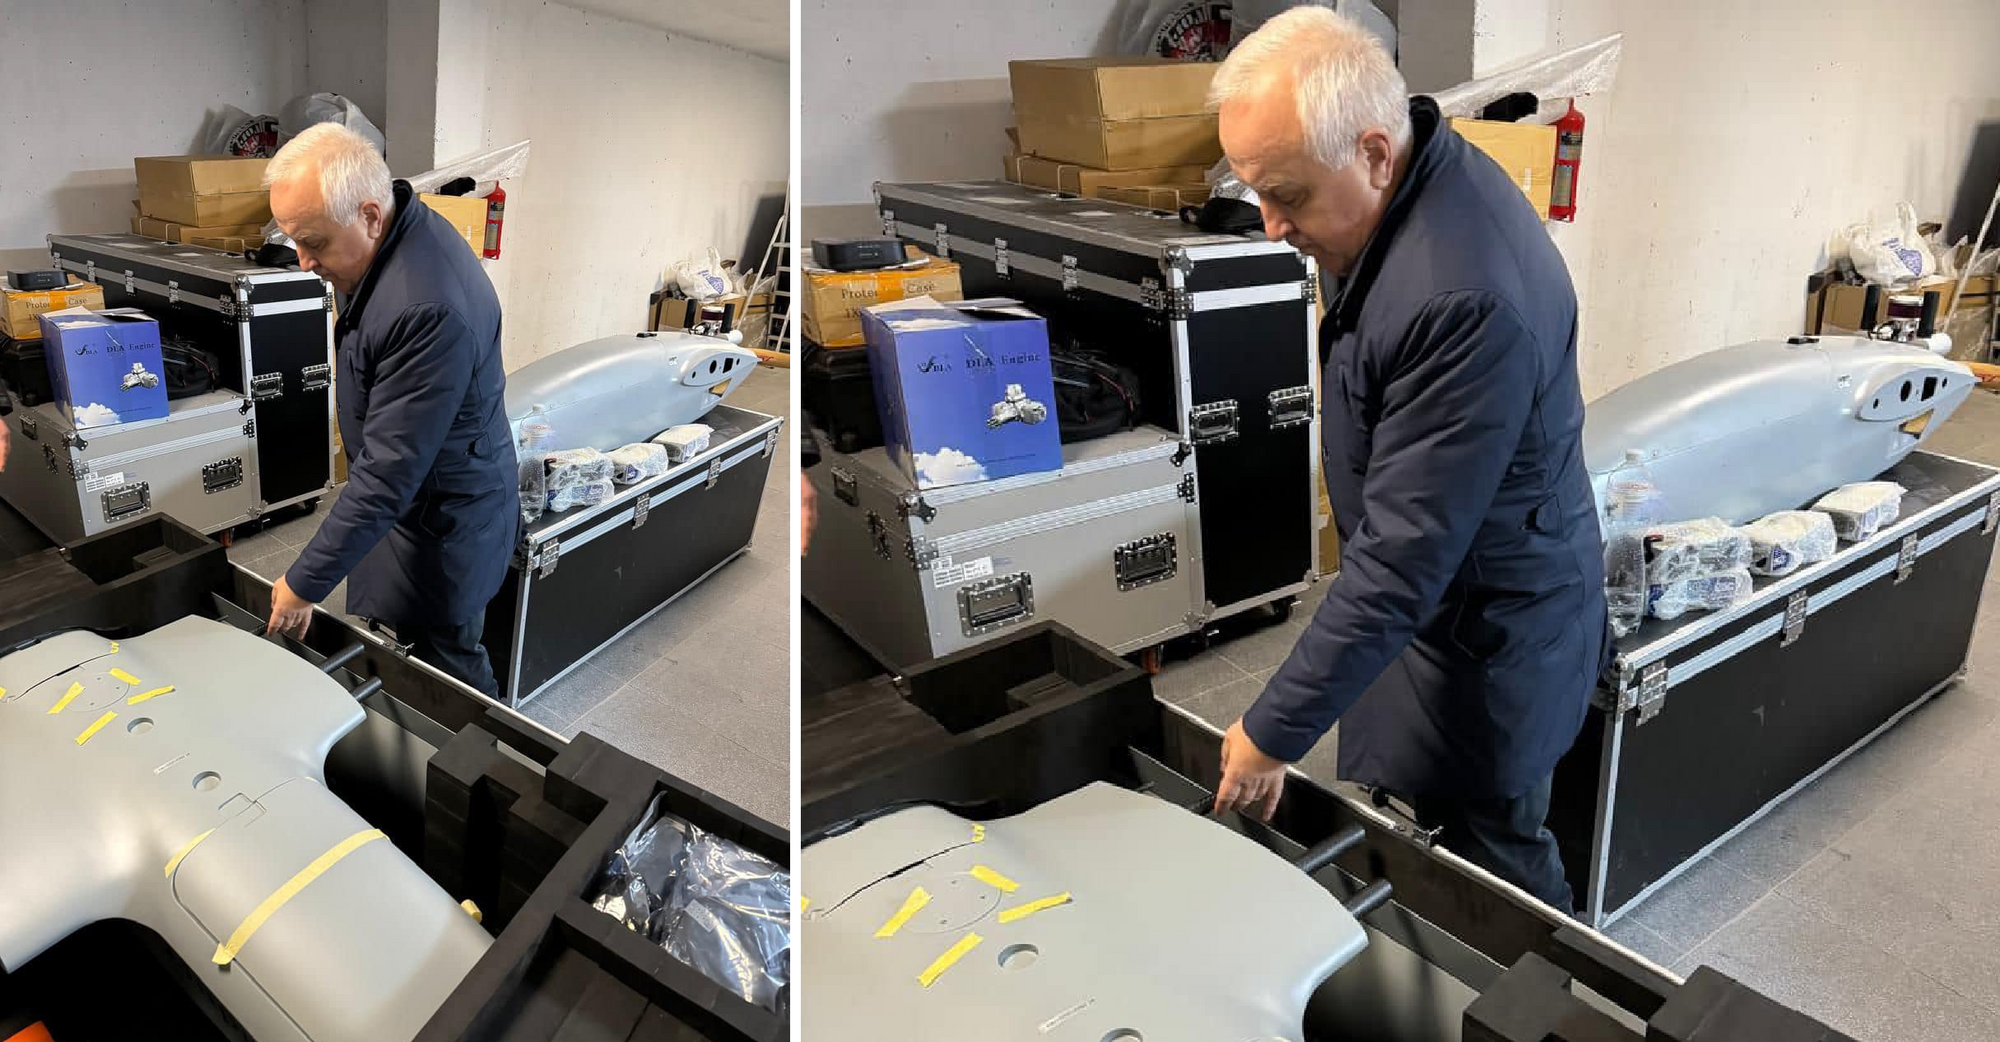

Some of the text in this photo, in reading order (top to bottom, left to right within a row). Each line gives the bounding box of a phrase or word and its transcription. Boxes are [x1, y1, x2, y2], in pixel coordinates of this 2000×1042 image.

[906, 283, 935, 293] Case
[106, 342, 155, 353] DLA Engine
[965, 353, 1040, 369] DLA Engine
